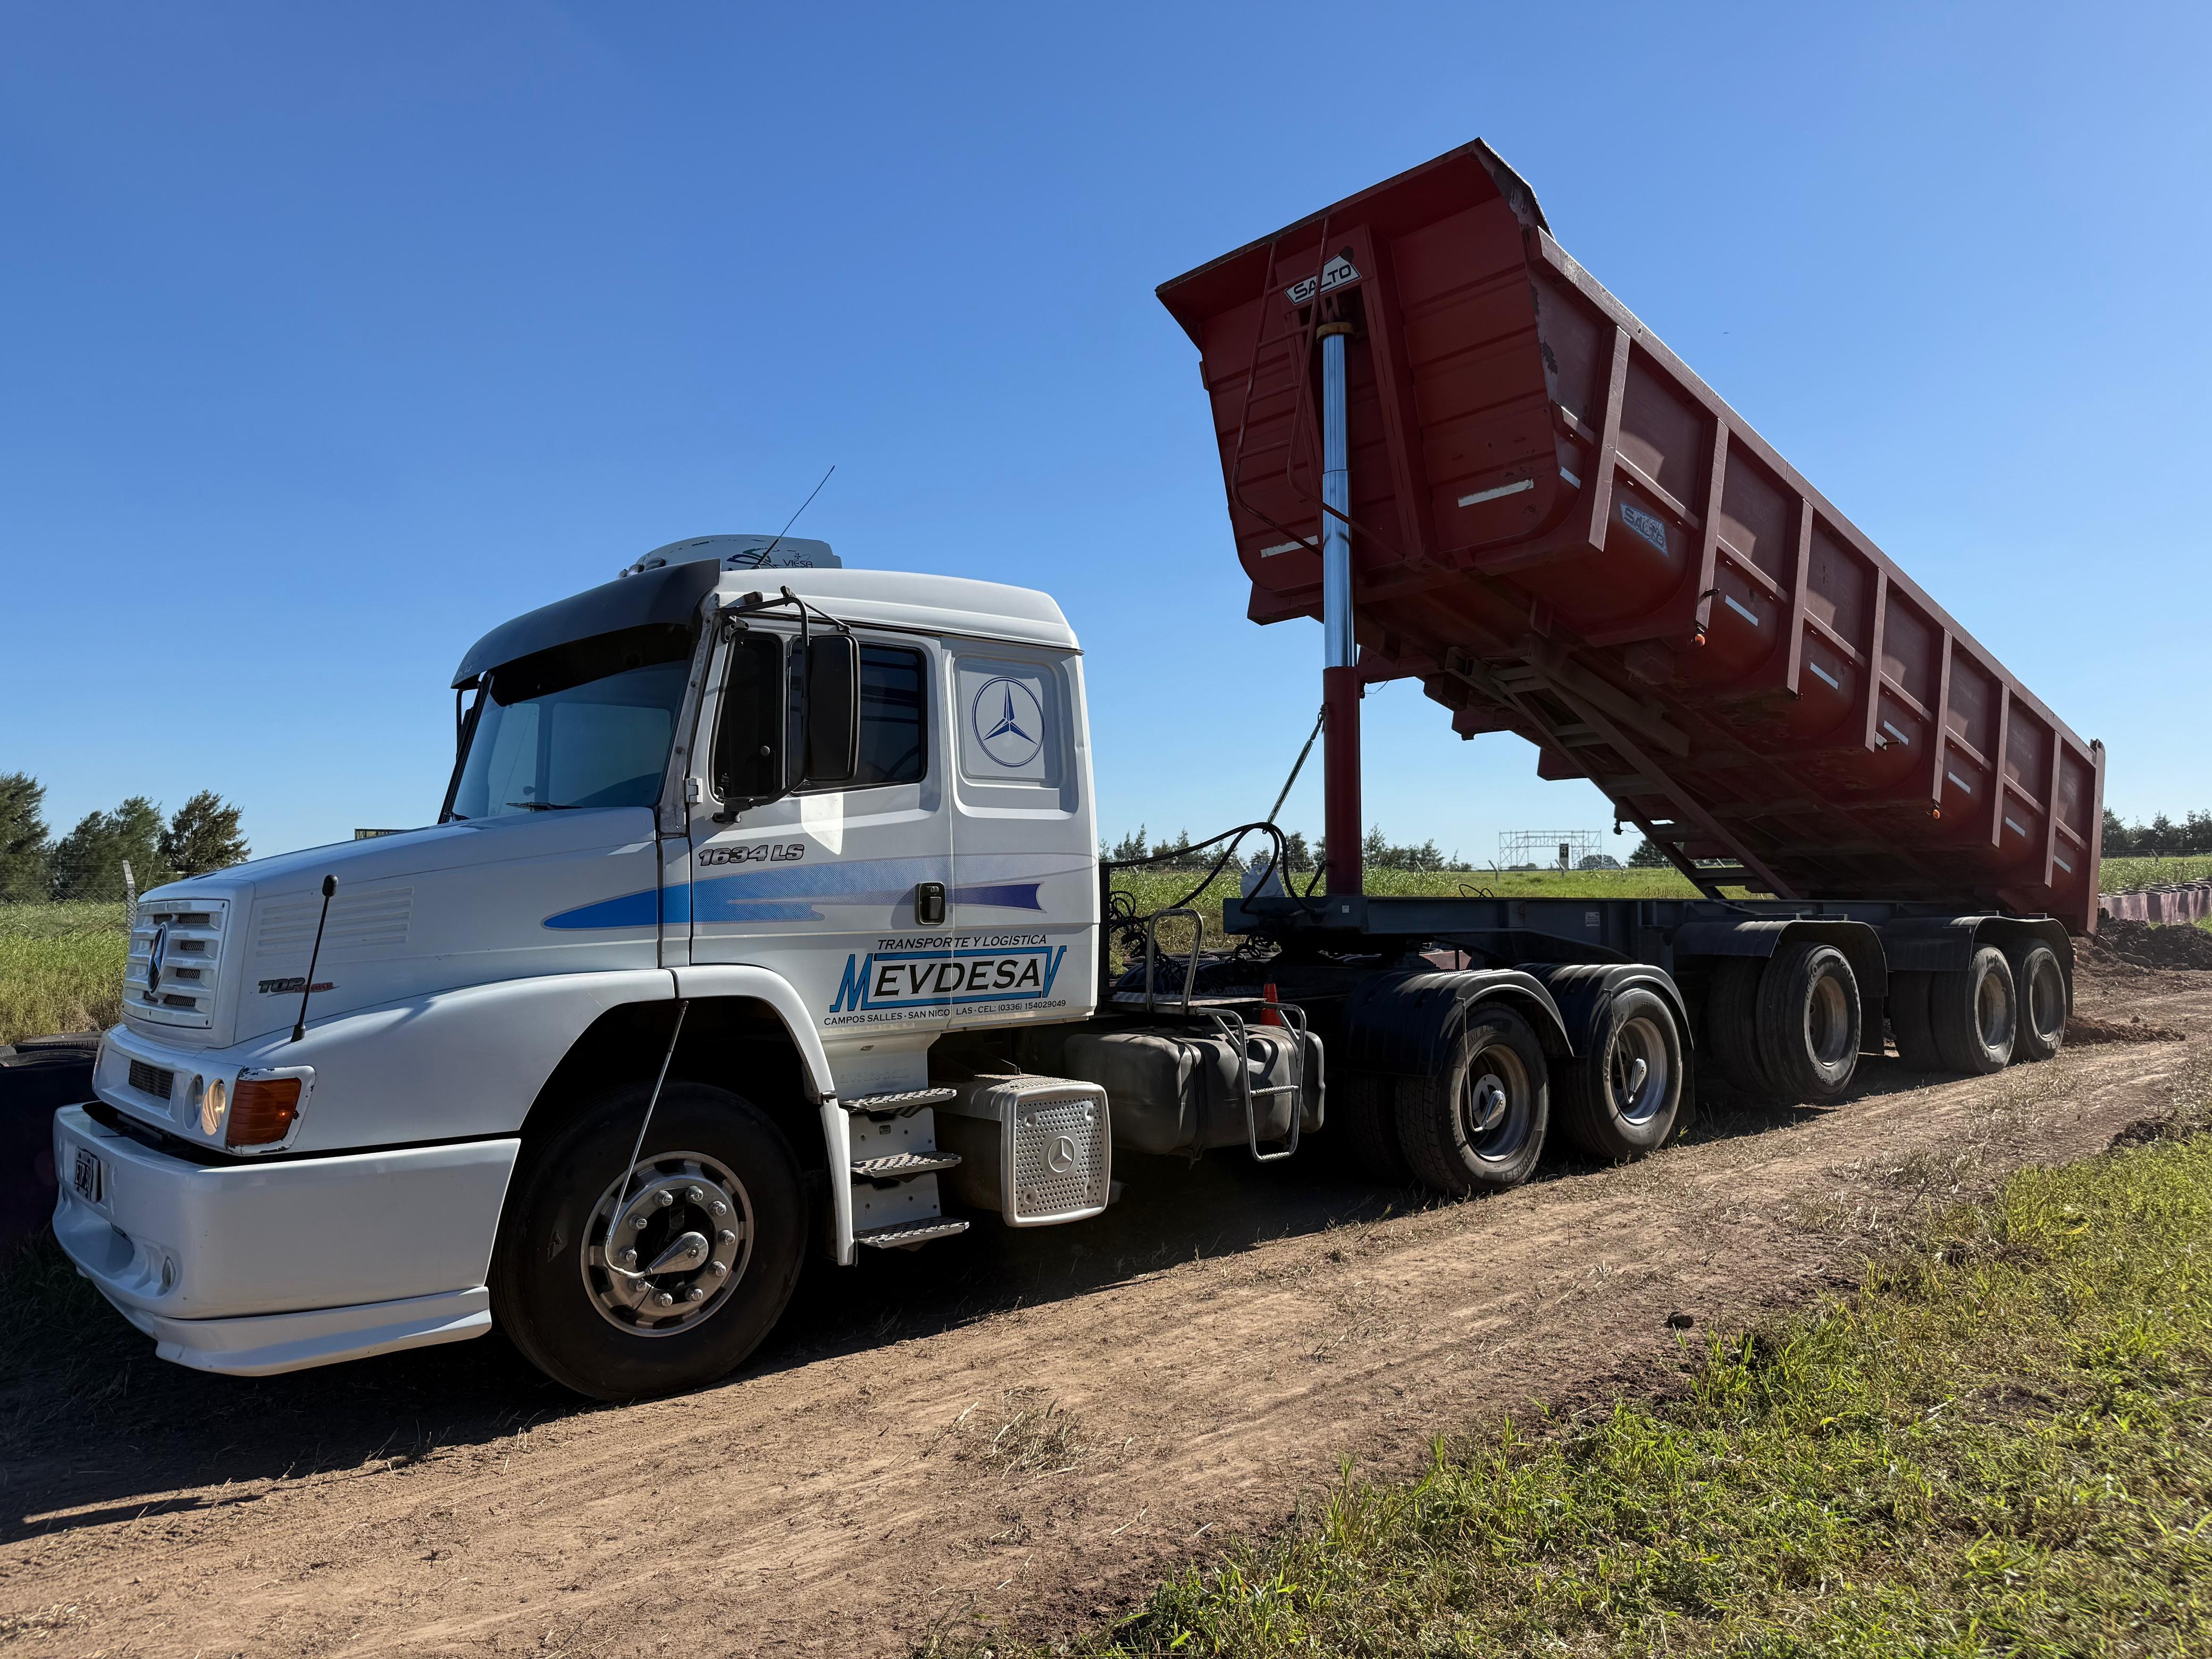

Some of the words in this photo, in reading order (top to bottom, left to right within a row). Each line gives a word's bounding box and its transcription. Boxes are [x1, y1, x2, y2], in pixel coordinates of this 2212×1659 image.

[783, 559, 813, 568] VIESA
[699, 844, 769, 866] 1634
[770, 844, 805, 861] LS
[877, 937, 970, 950] TRANSPORTE
[974, 936, 982, 946] Y
[982, 934, 1047, 946] LOGISTICA
[258, 977, 305, 994] TOP
[824, 1015, 865, 1026] CAMPOS
[867, 1012, 903, 1022] SALLES
[908, 1010, 926, 1019] SAN
[998, 1003, 1022, 1012] (0336)
[1025, 1000, 1066, 1010] 154029049
